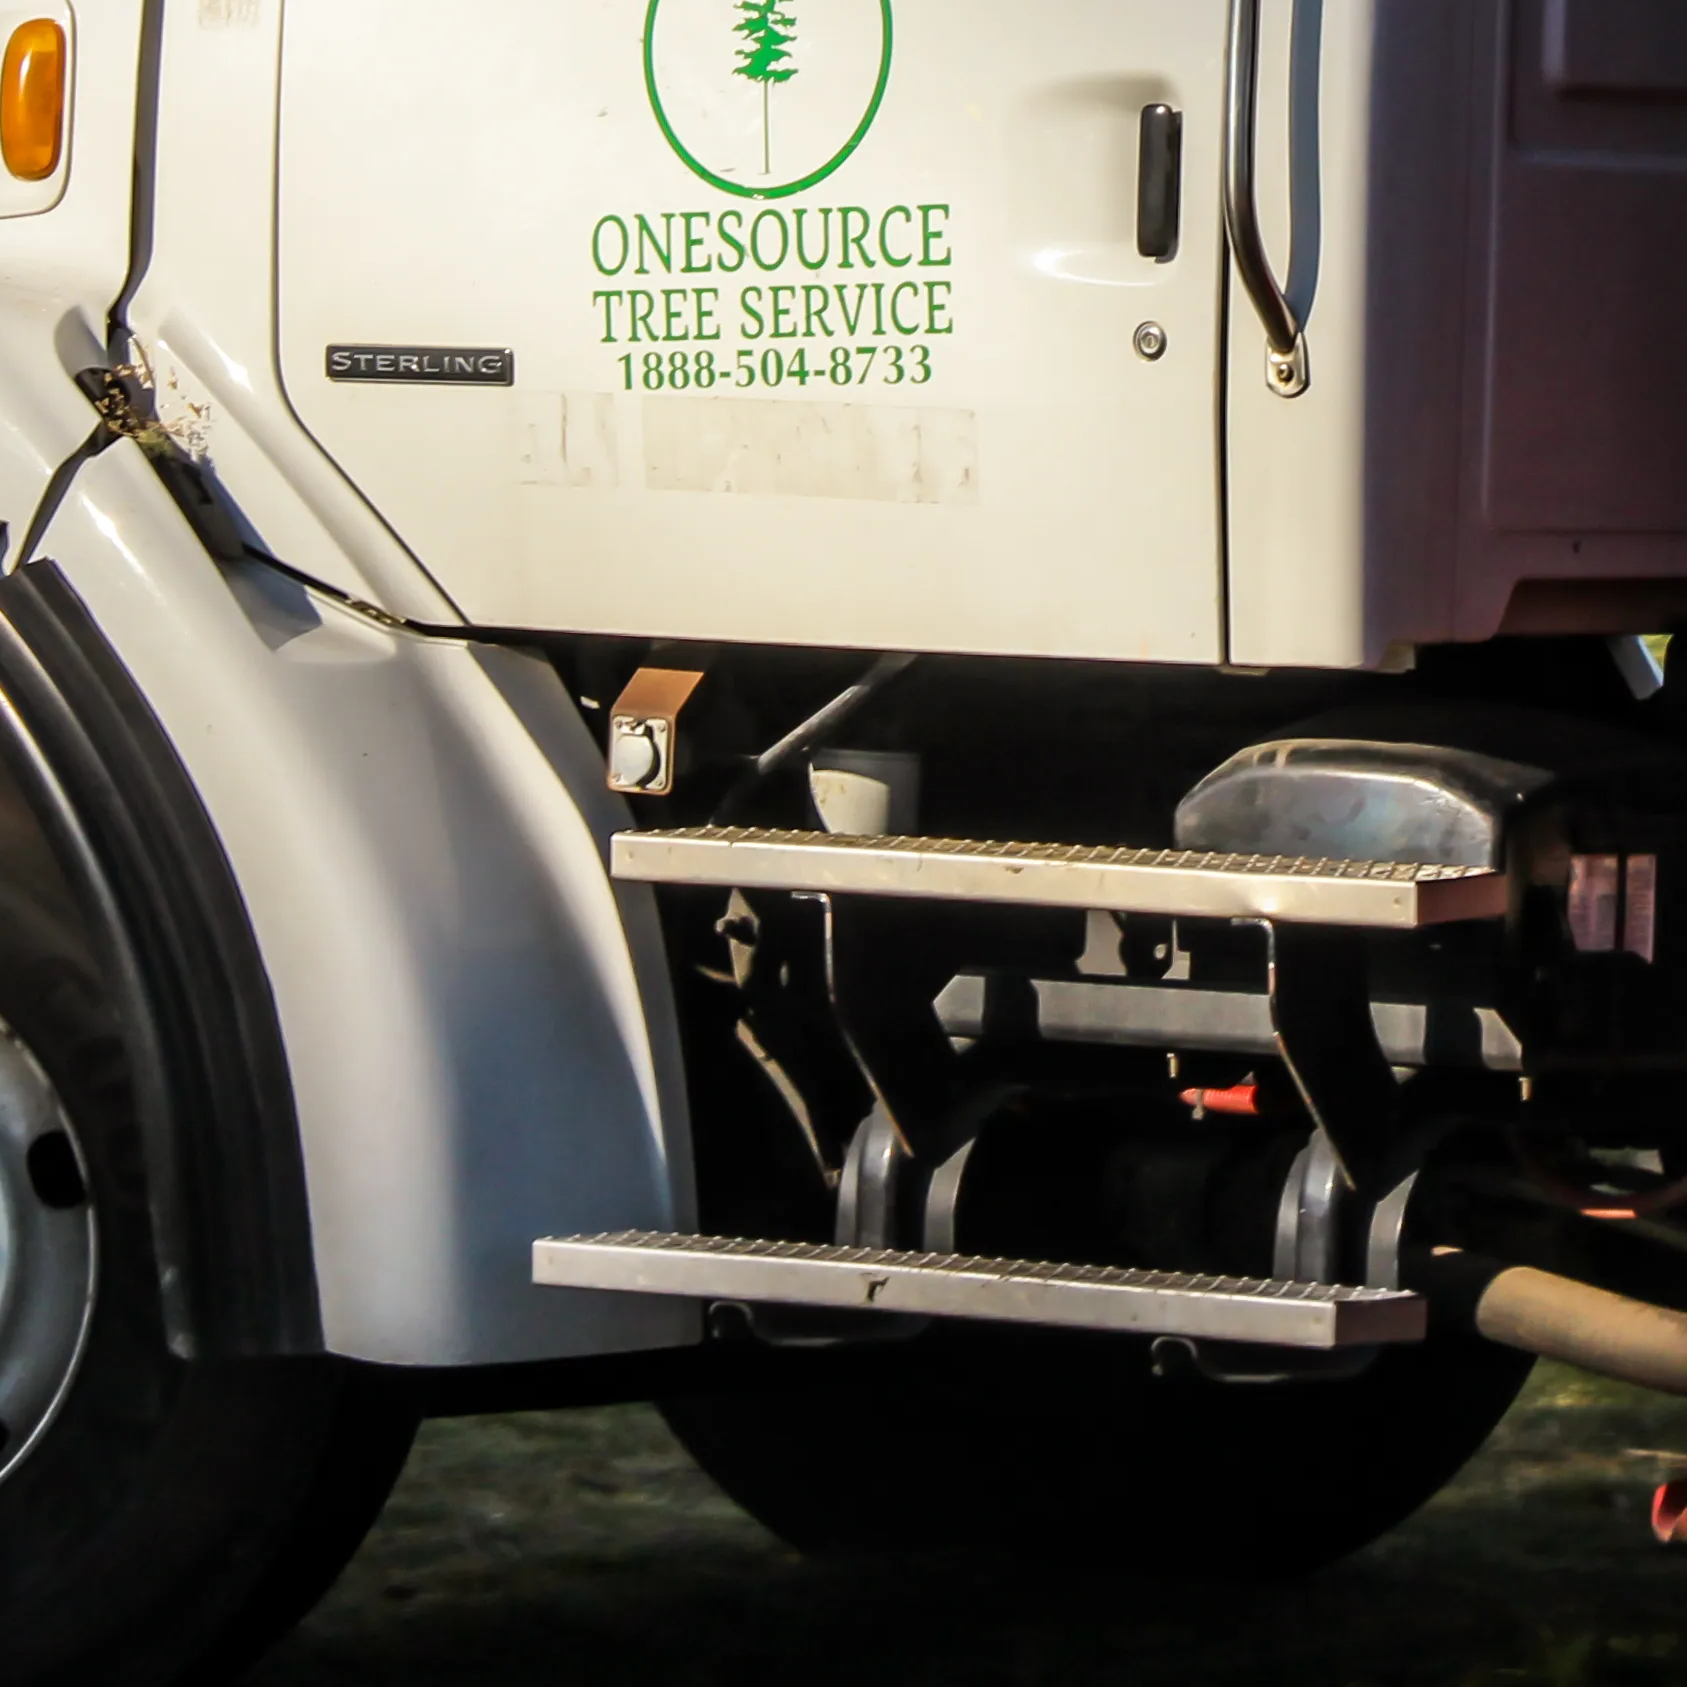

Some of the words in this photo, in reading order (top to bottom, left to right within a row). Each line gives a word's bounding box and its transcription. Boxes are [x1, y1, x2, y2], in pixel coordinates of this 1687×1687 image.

[591, 203, 953, 276] ONESOURCE
[592, 287, 721, 343] TREE
[740, 280, 954, 340] SERVICE
[331, 351, 502, 374] STERLING
[617, 344, 932, 390] 1888-504-8733
